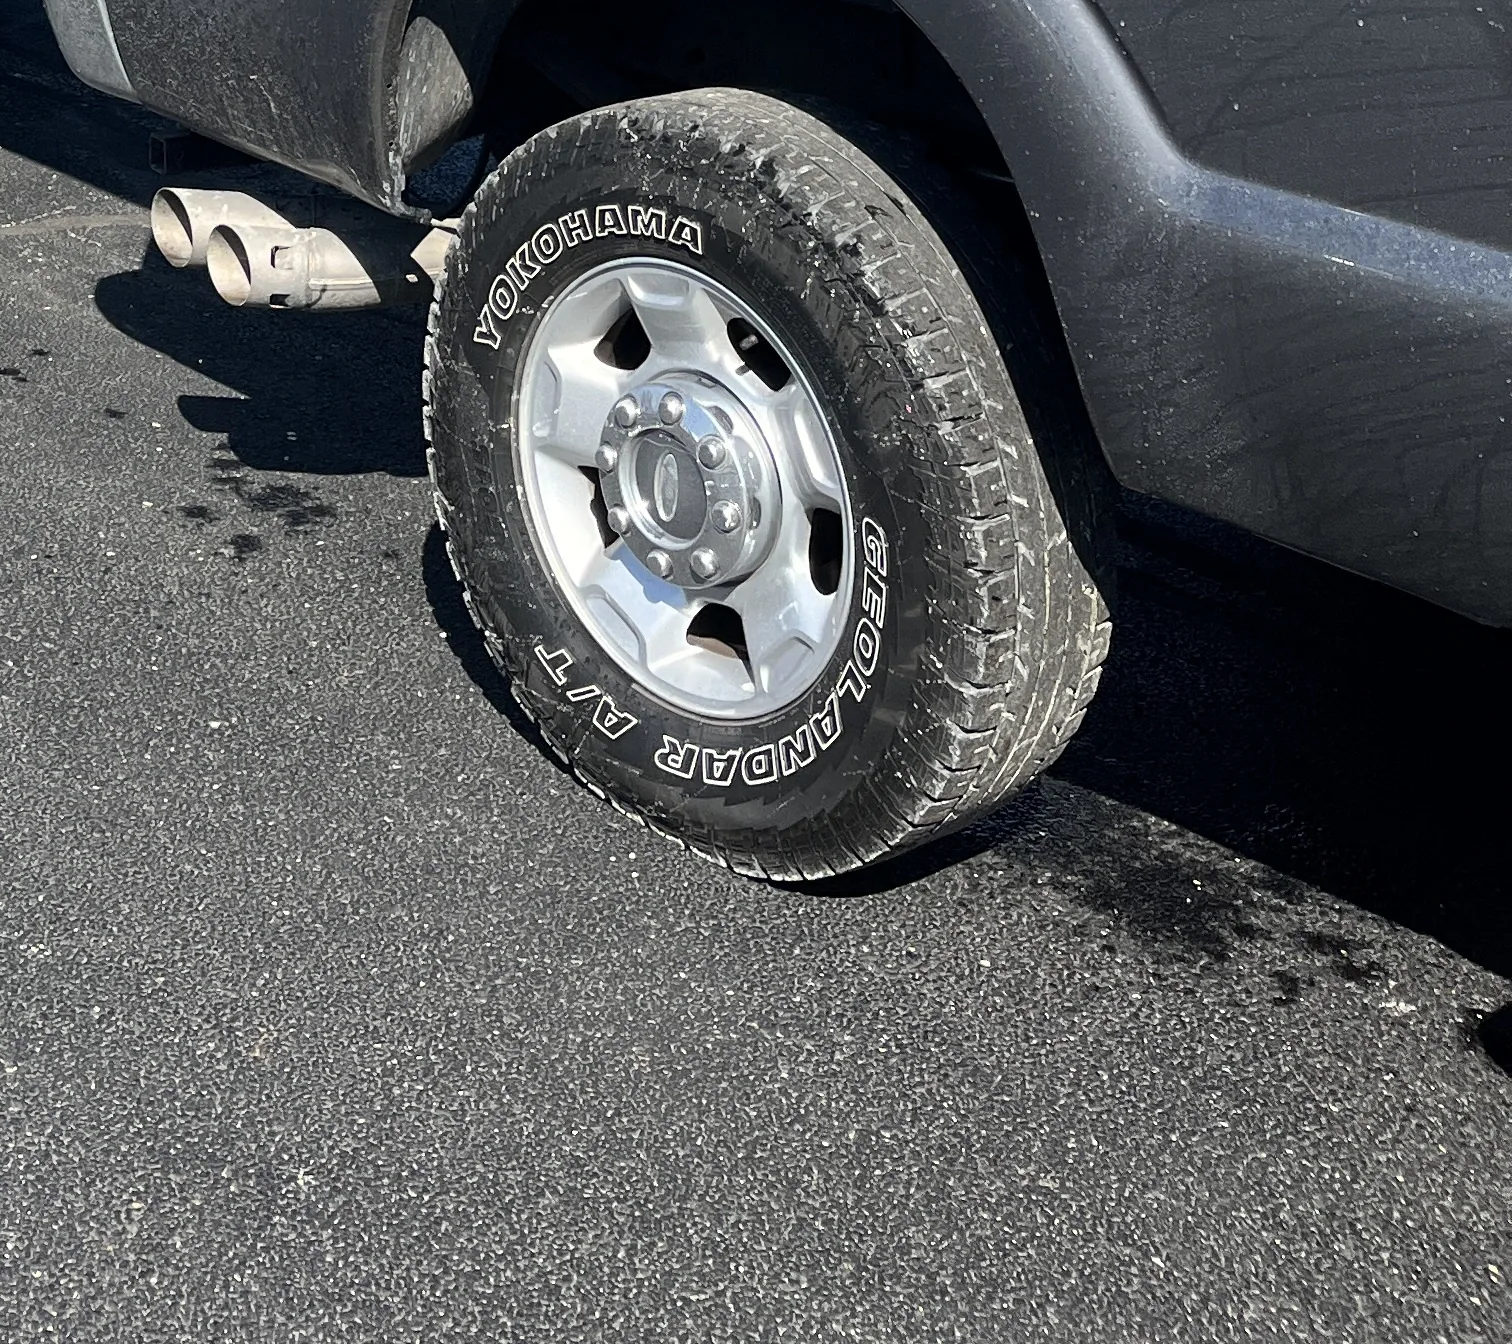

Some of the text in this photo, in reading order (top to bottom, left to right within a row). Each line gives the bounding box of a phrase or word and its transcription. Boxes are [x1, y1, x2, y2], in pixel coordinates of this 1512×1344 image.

[473, 204, 703, 350] YOKOHAMA
[534, 517, 888, 786] GEOLANDAR A/T
